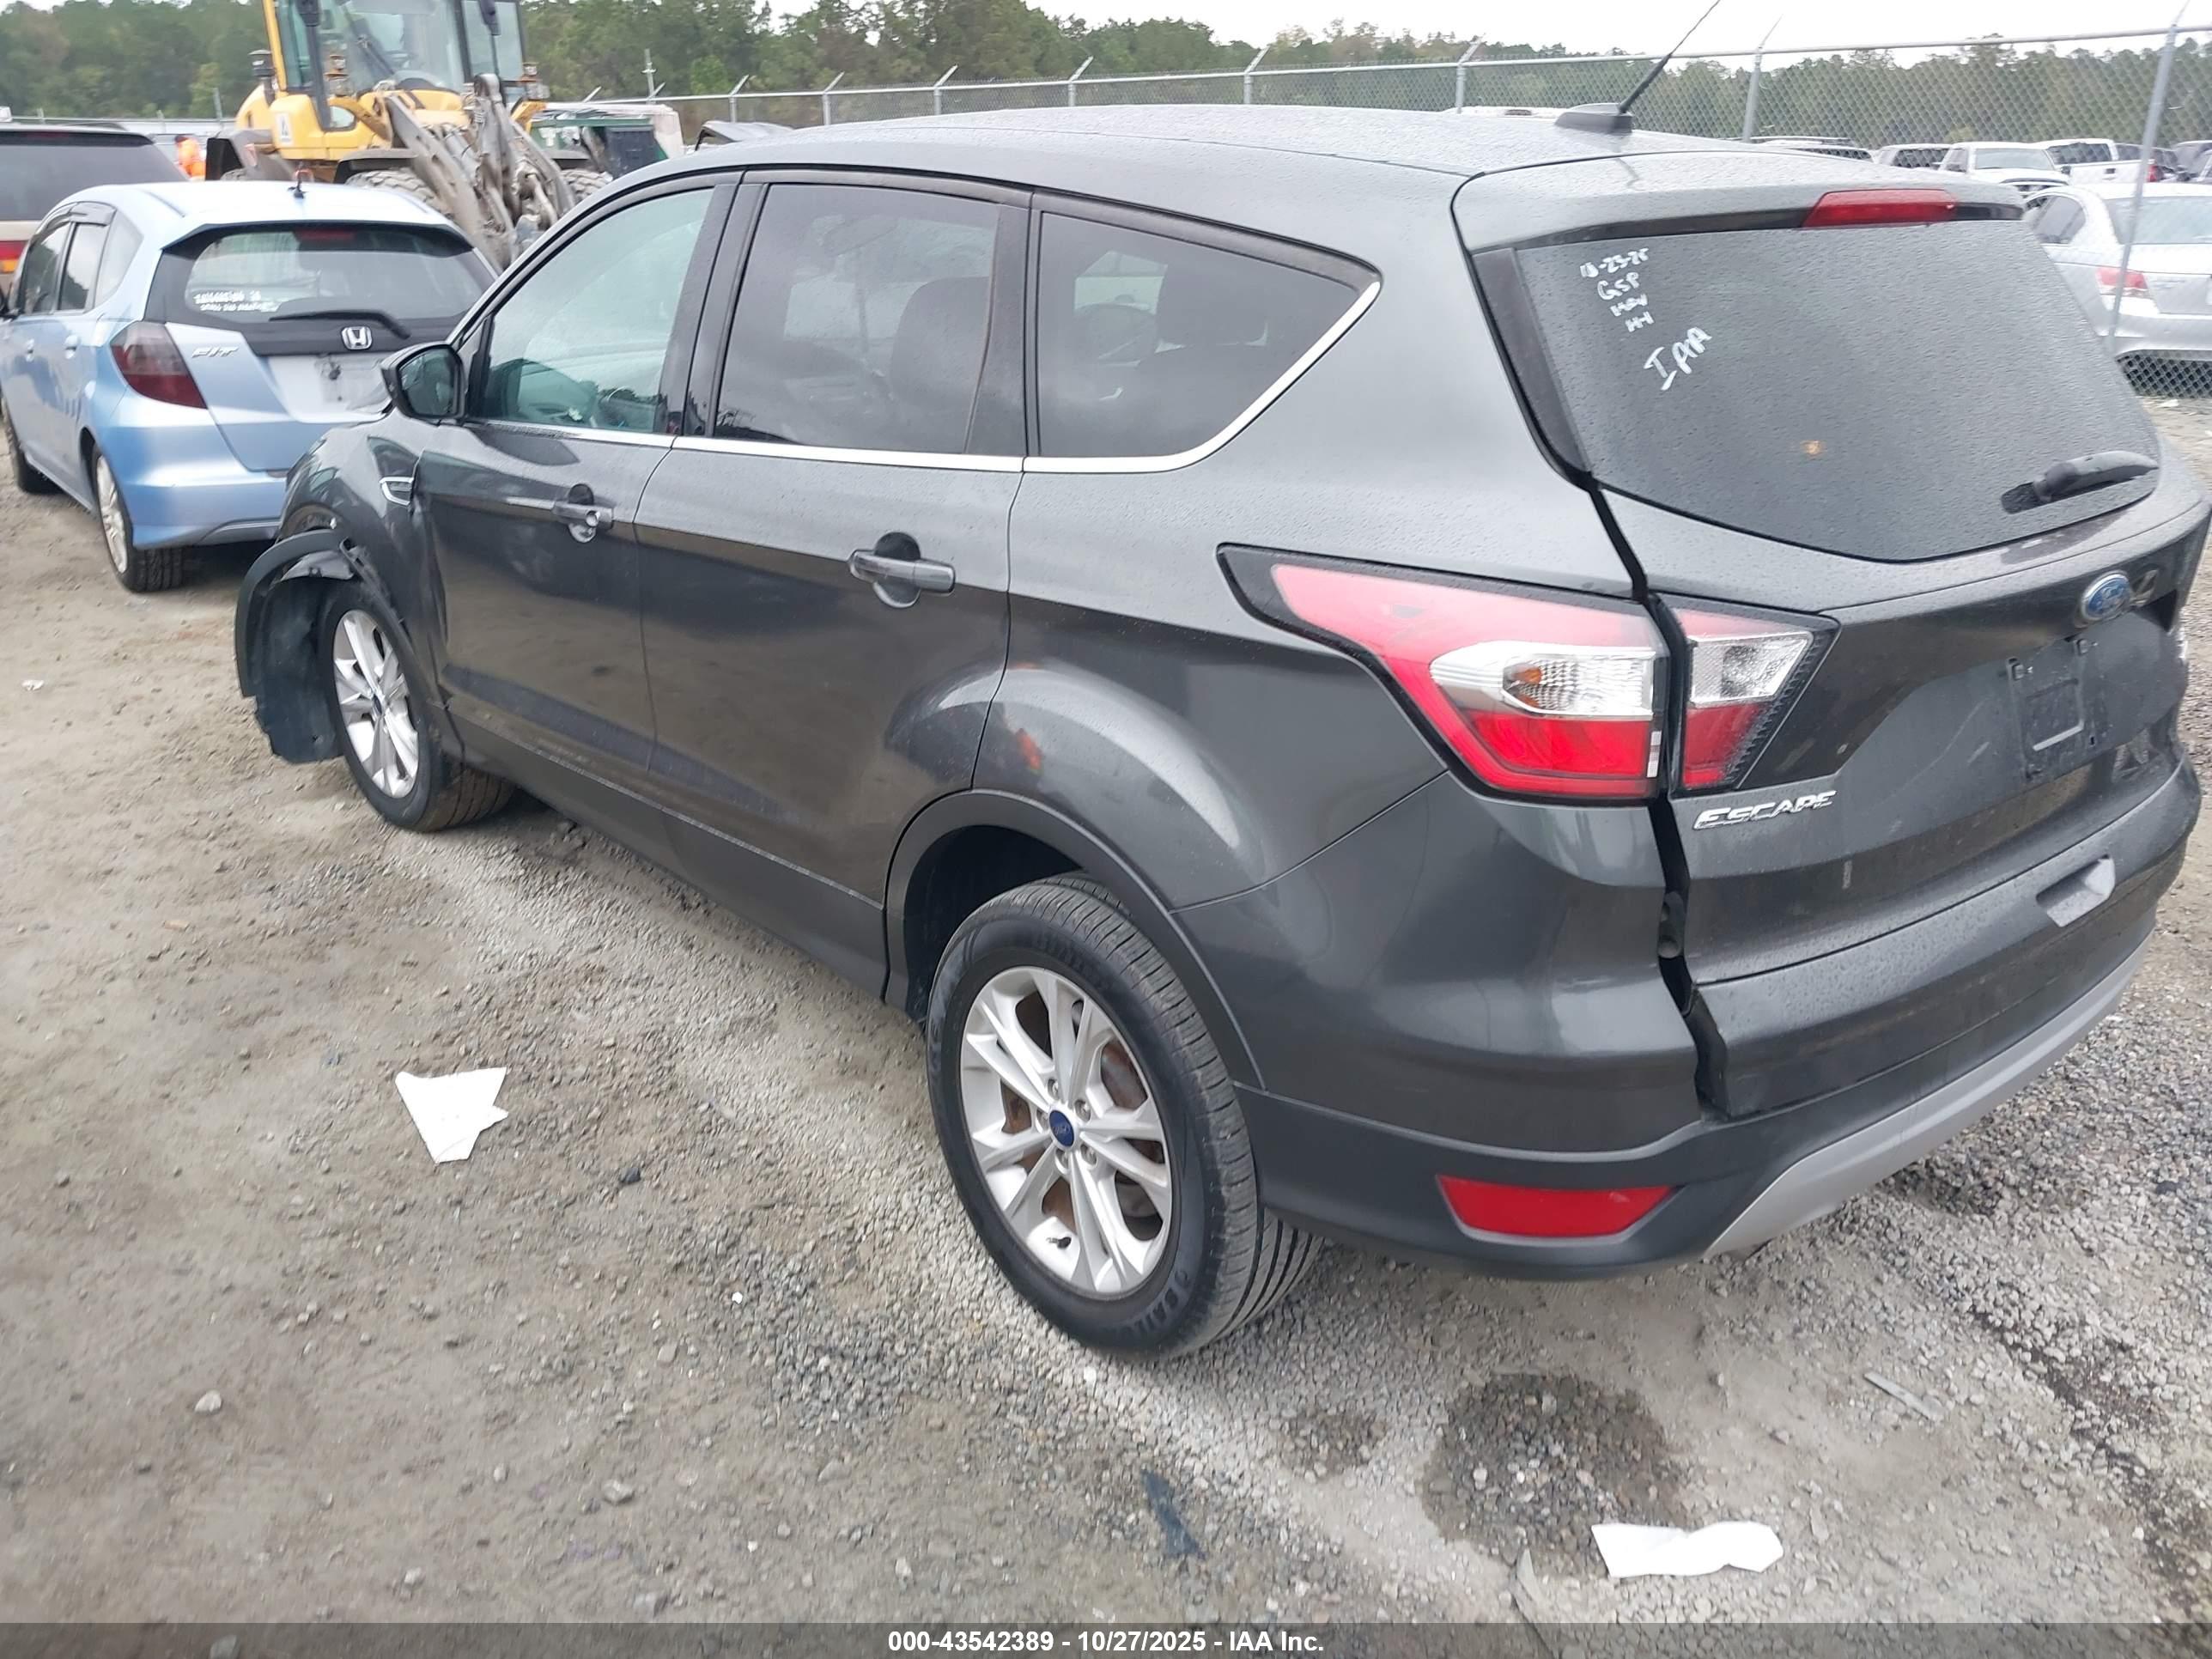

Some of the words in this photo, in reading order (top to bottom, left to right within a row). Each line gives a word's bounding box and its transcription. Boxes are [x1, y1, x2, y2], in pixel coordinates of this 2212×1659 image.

[1597, 272, 1639, 300] GSP
[1644, 326, 1712, 391] IAA
[1693, 790, 1837, 830] ESCAPE
